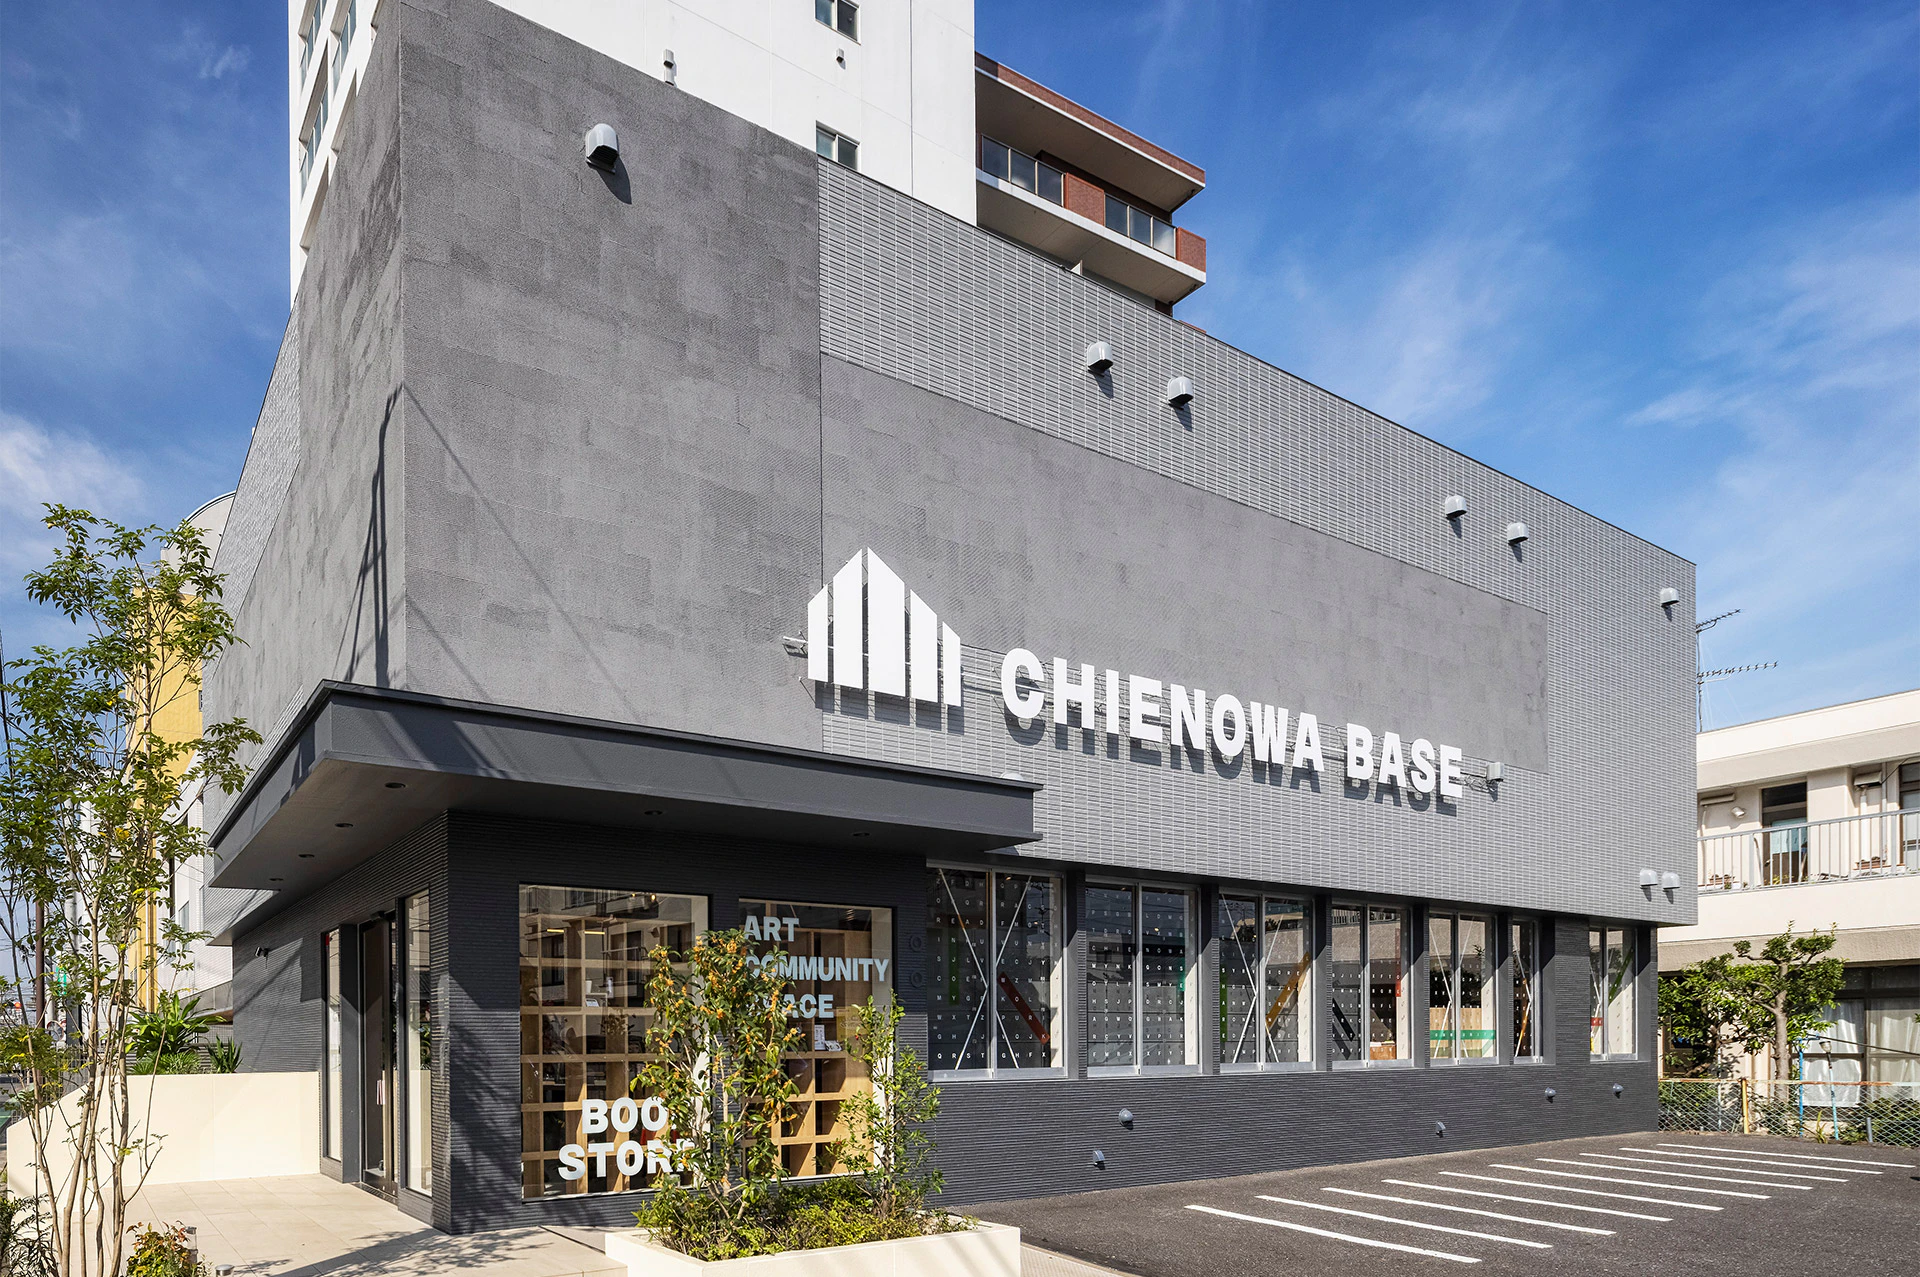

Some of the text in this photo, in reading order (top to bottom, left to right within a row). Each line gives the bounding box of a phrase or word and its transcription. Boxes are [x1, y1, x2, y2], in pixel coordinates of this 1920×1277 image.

[1001, 647, 1463, 798] CHIENOWA BASE
[743, 915, 800, 942] ART
[746, 993, 834, 1019] ACE
[582, 1097, 690, 1134] BOO
